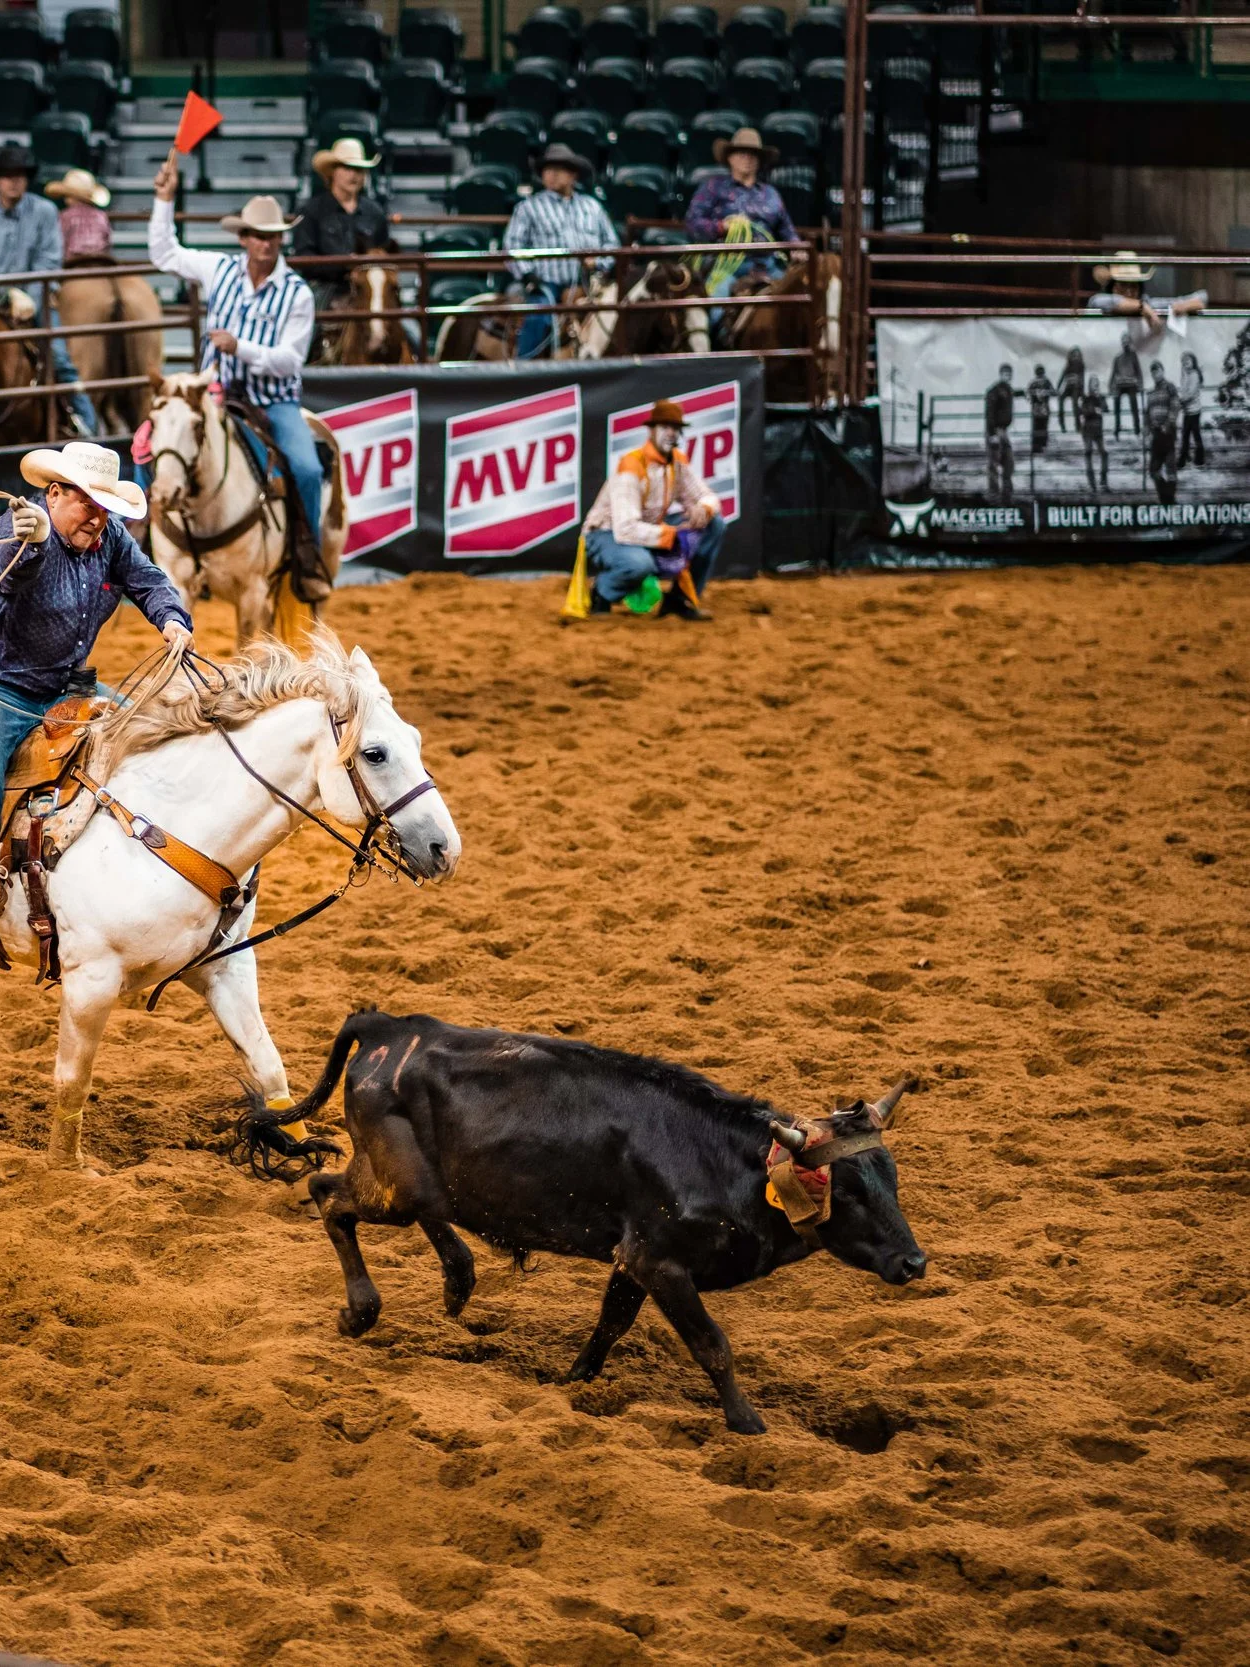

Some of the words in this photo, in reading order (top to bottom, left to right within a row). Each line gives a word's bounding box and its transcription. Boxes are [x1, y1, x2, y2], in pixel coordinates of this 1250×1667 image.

[343, 437, 413, 497] VP
[450, 432, 576, 508] MVP
[930, 508, 1025, 527] MACKSTEEL
[1048, 506, 1097, 527] BUILT
[1100, 506, 1134, 527] FOR
